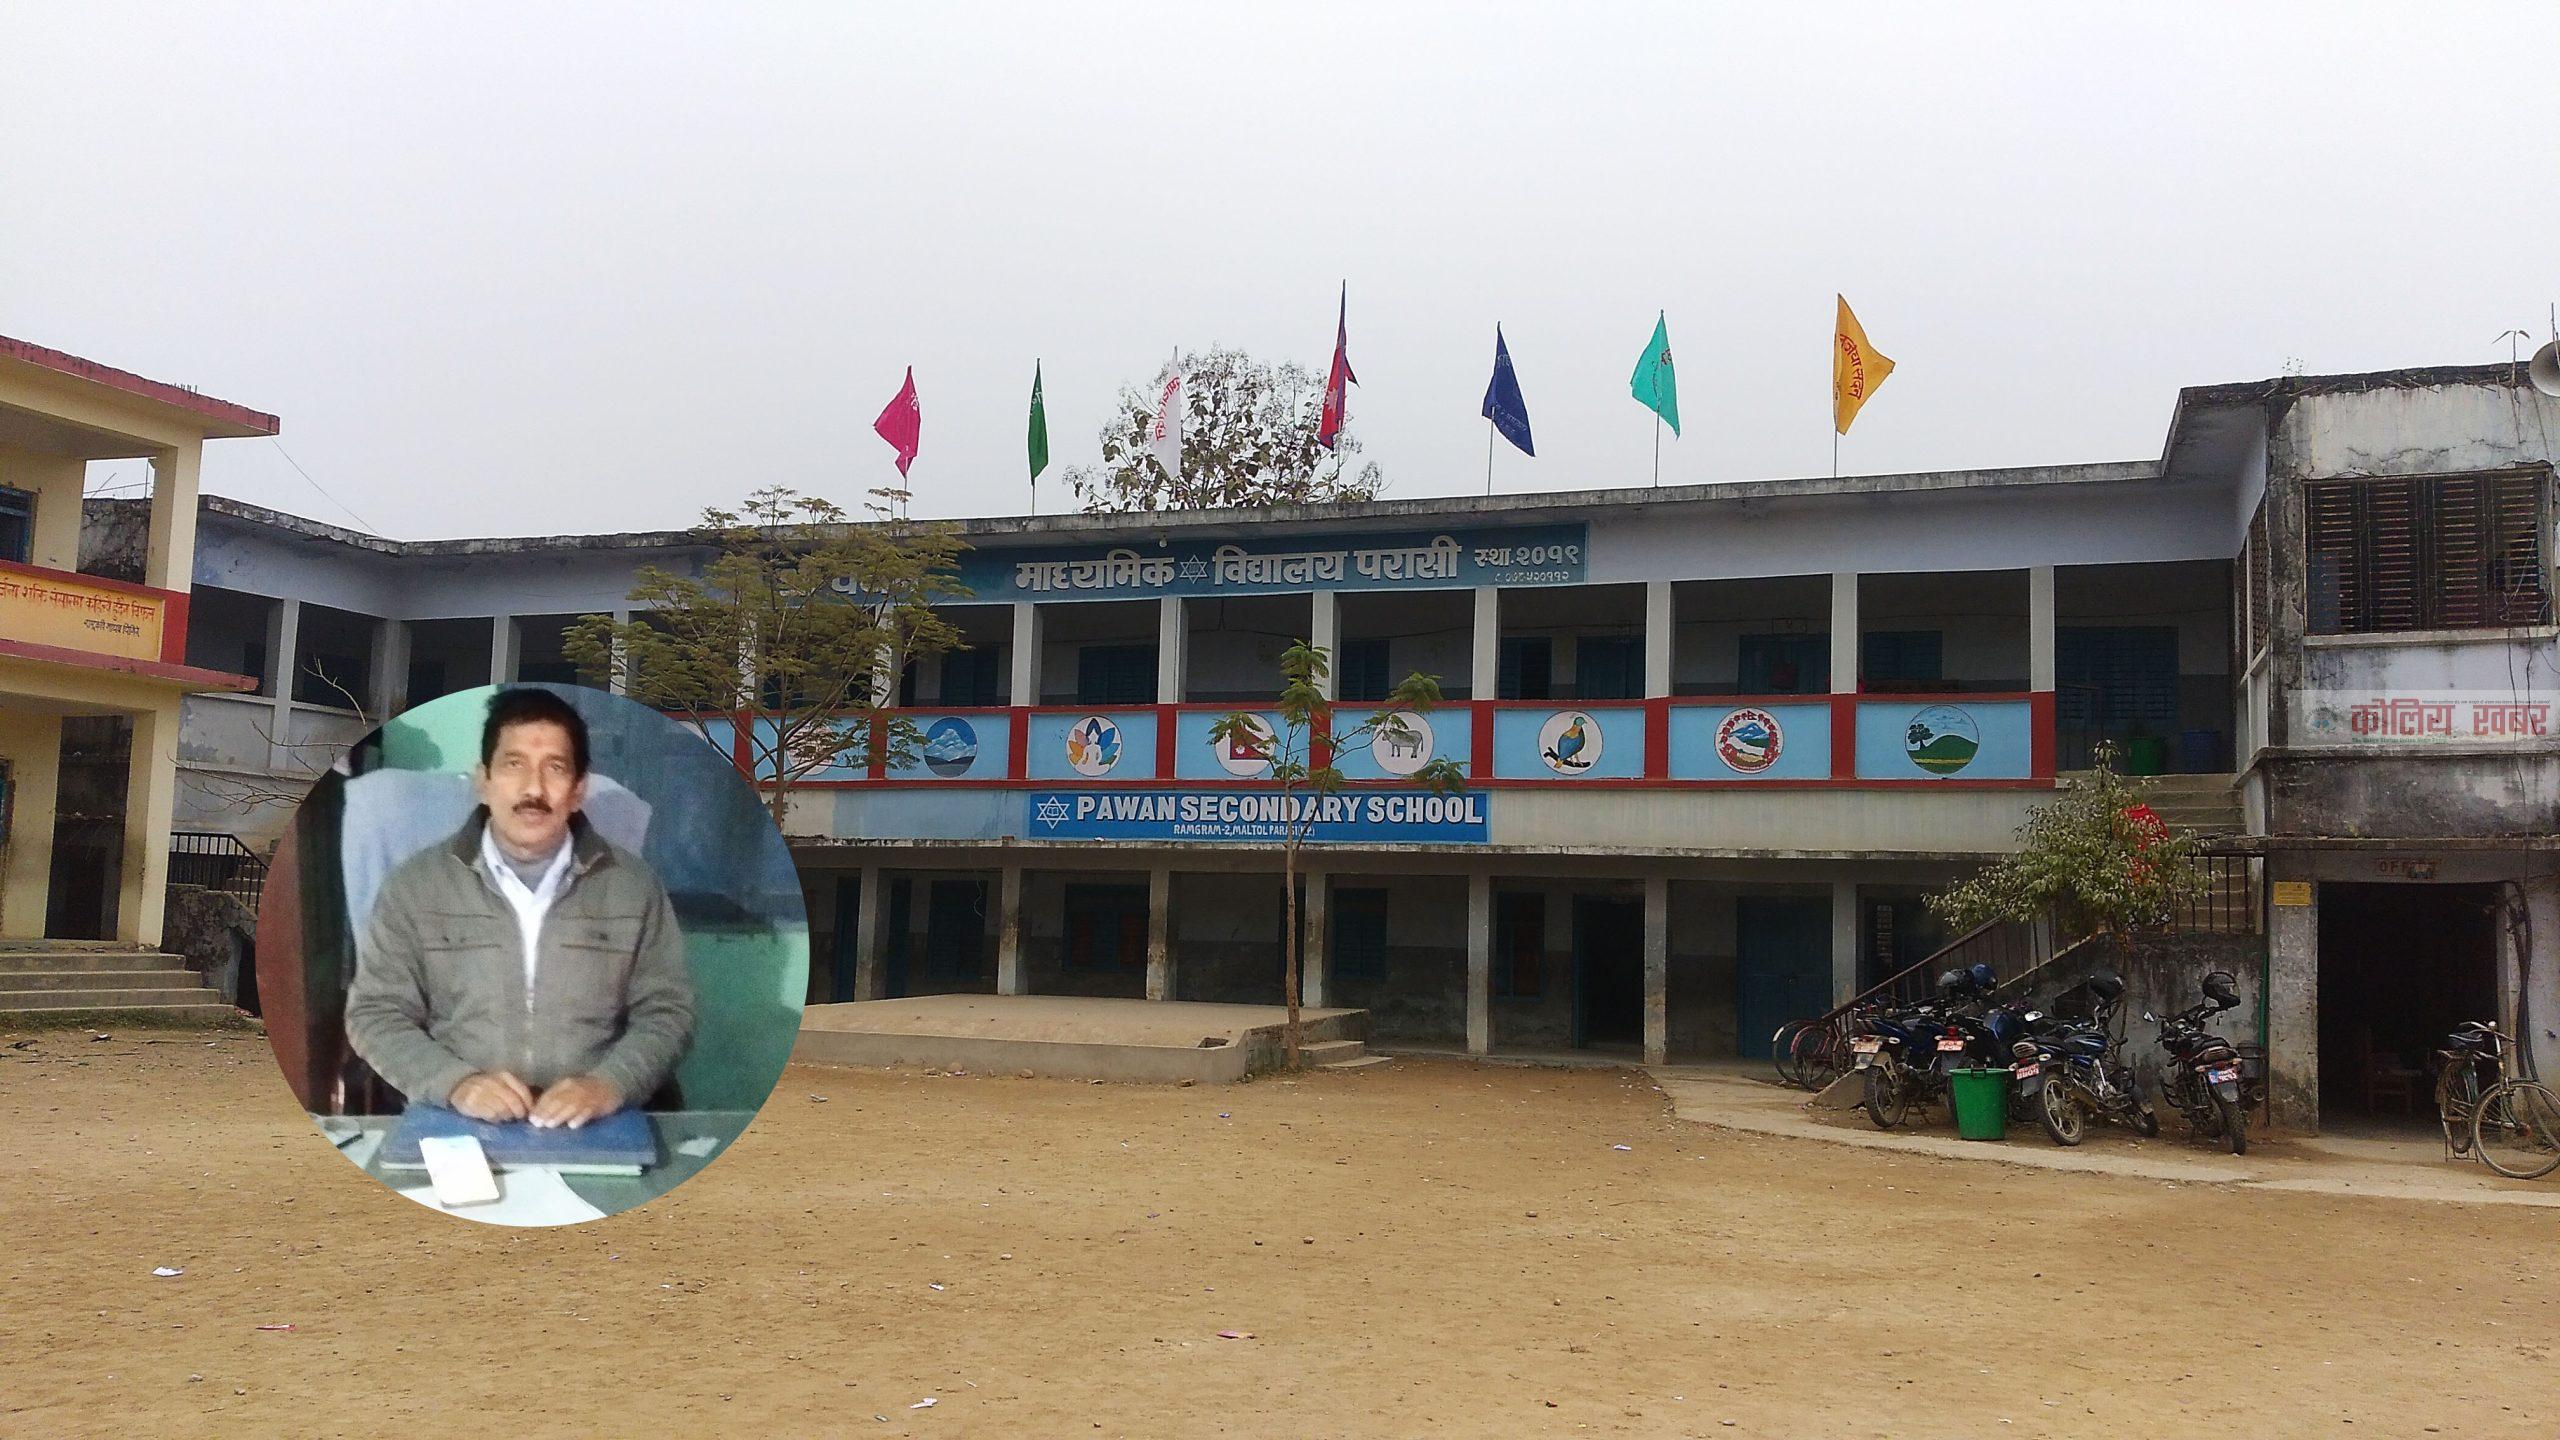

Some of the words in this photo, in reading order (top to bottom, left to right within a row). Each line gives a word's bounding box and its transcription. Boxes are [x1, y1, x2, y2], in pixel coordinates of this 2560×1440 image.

[1016, 549, 1175, 592] माध्यमिक
[1213, 545, 1347, 585] विद्यालय
[1353, 535, 1462, 580] परासी
[1076, 796, 1176, 822] PAWAN
[1180, 795, 1361, 823] SECONDARY
[1366, 796, 1484, 824] SCHOOL
